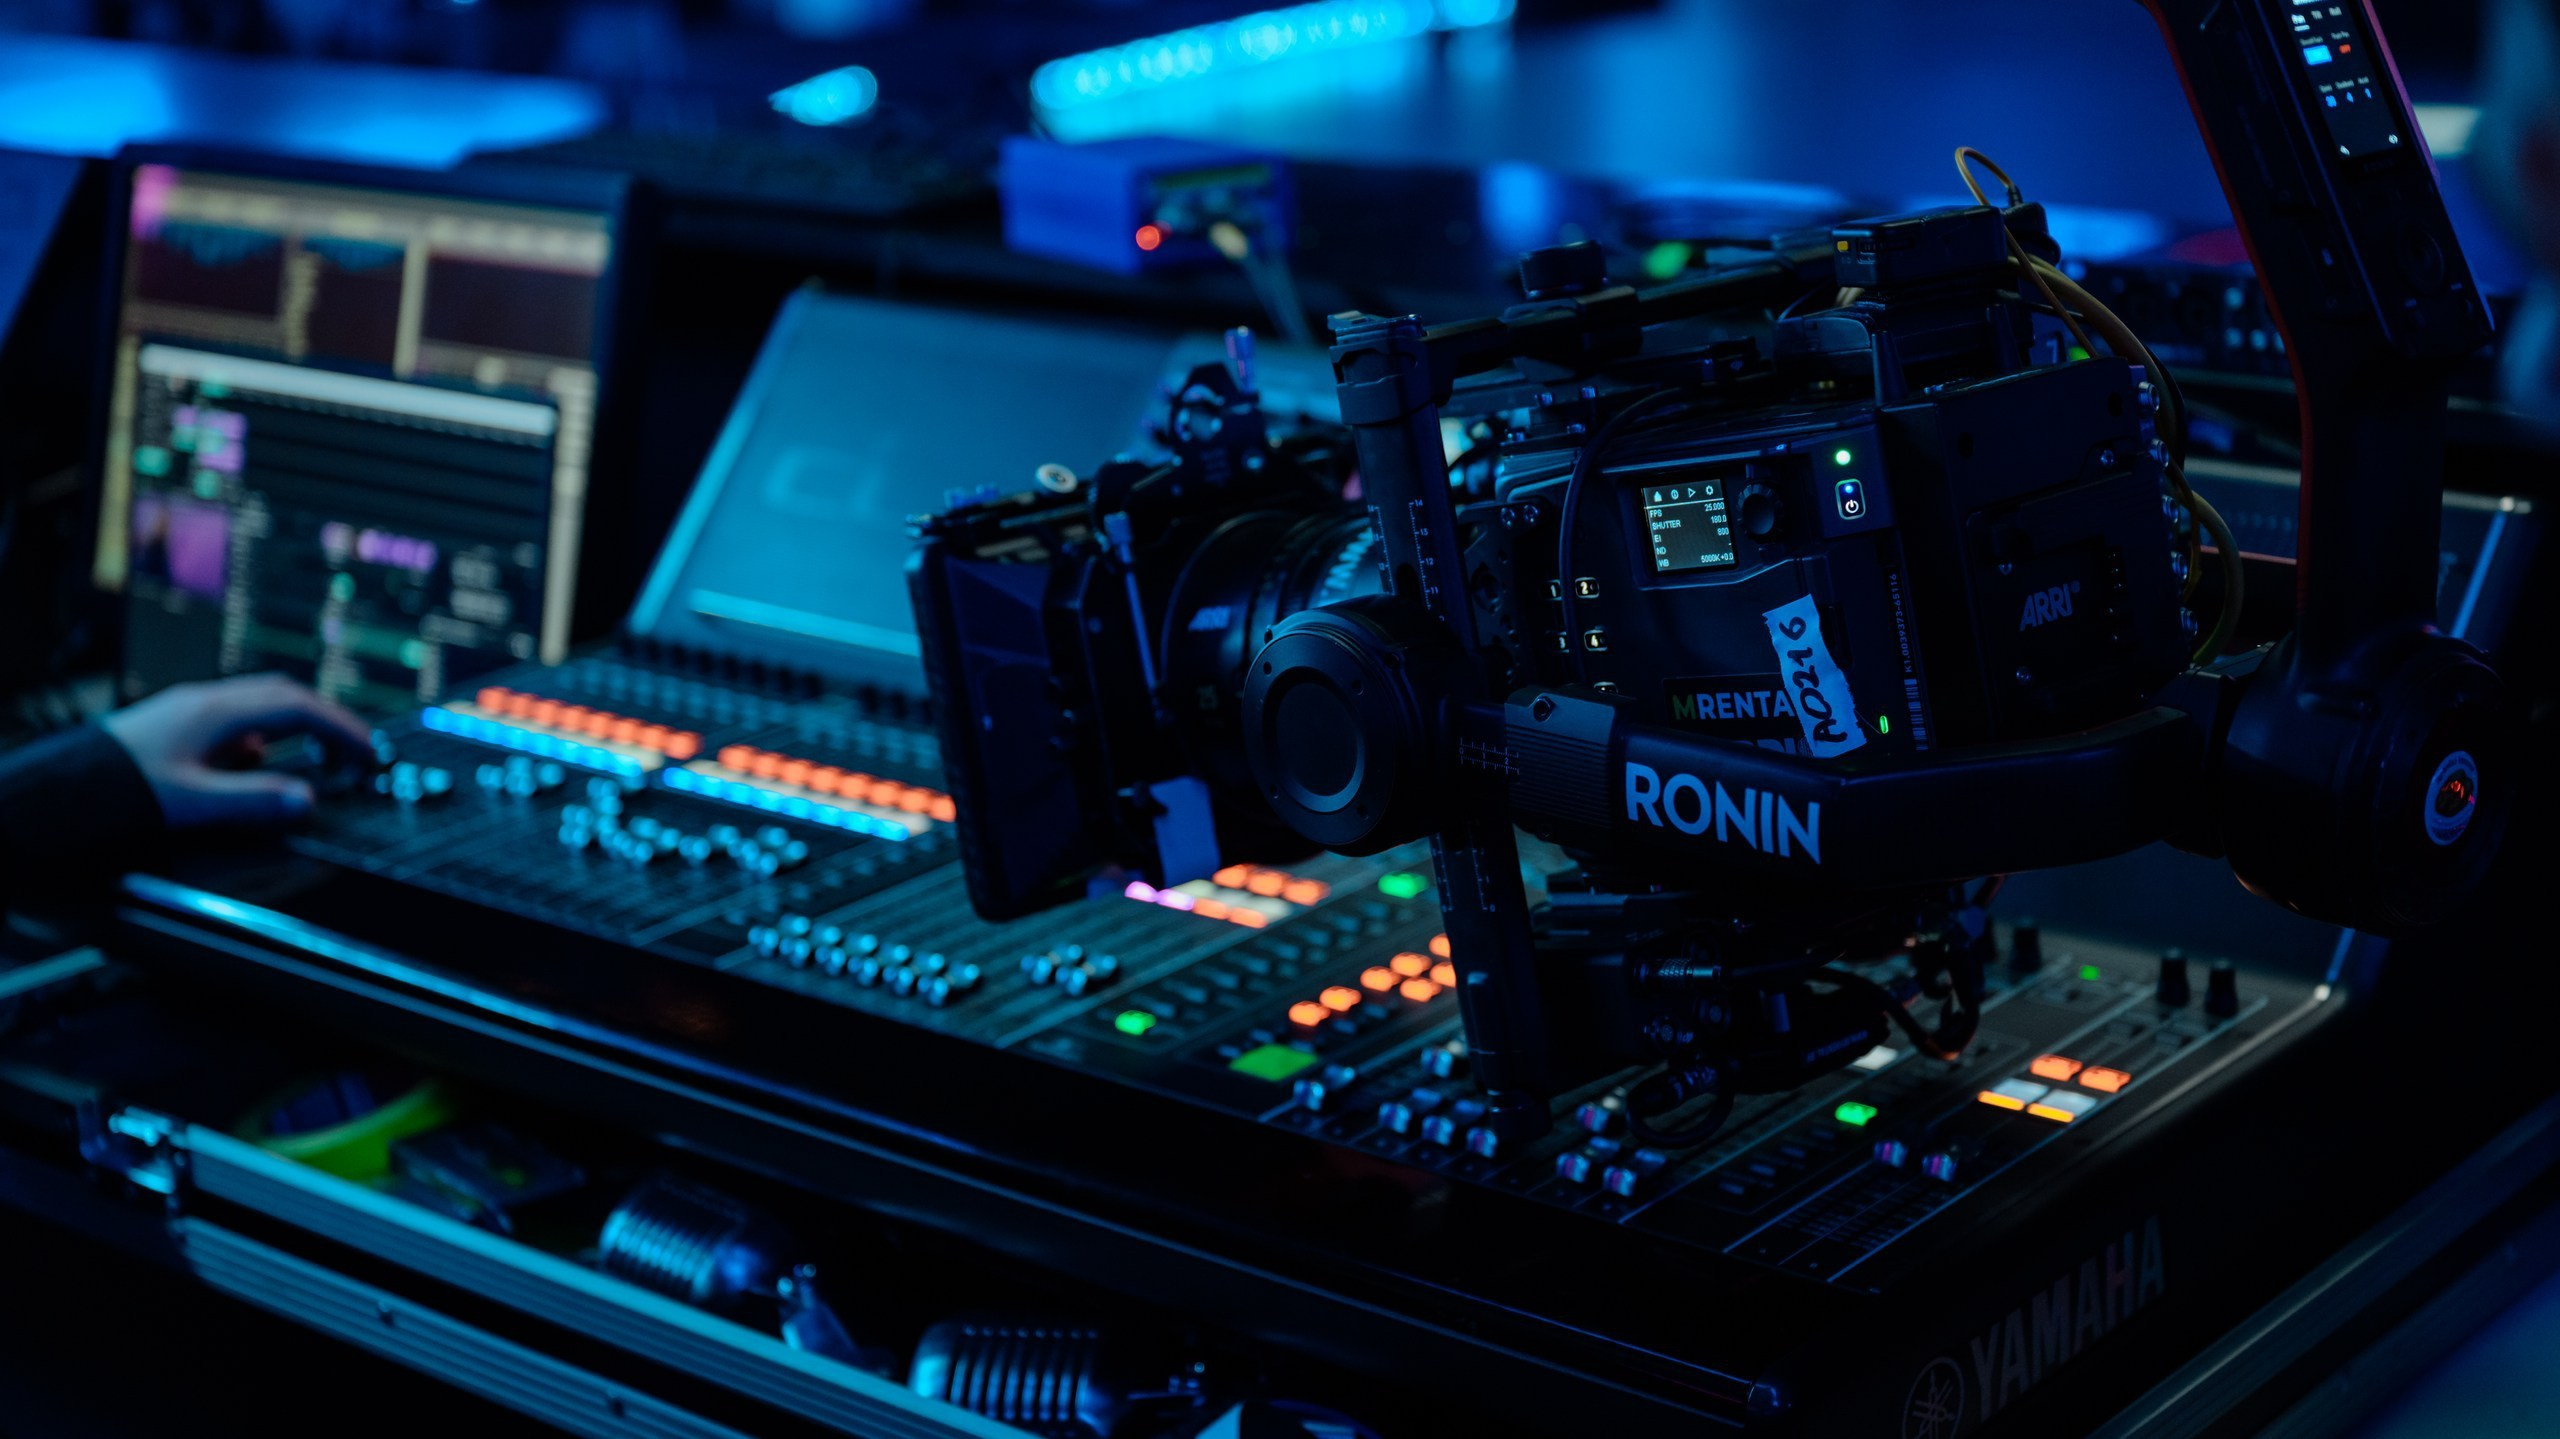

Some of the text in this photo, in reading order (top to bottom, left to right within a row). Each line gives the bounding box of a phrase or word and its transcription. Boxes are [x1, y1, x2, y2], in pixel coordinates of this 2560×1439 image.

[1649, 502, 1725, 518] FPS 25.000
[1652, 514, 1727, 531] SHUTTER 180.0
[1654, 527, 1729, 543] EI 800
[1656, 546, 1667, 555] ND
[1658, 558, 1670, 568] WB
[1579, 581, 1589, 595] 2
[2019, 583, 2073, 632] ARRI
[1778, 616, 1848, 743] A0216
[1671, 690, 1796, 721] MRENTA
[1625, 761, 1821, 865] RONIN
[1968, 1215, 2166, 1424] YAMAHA
